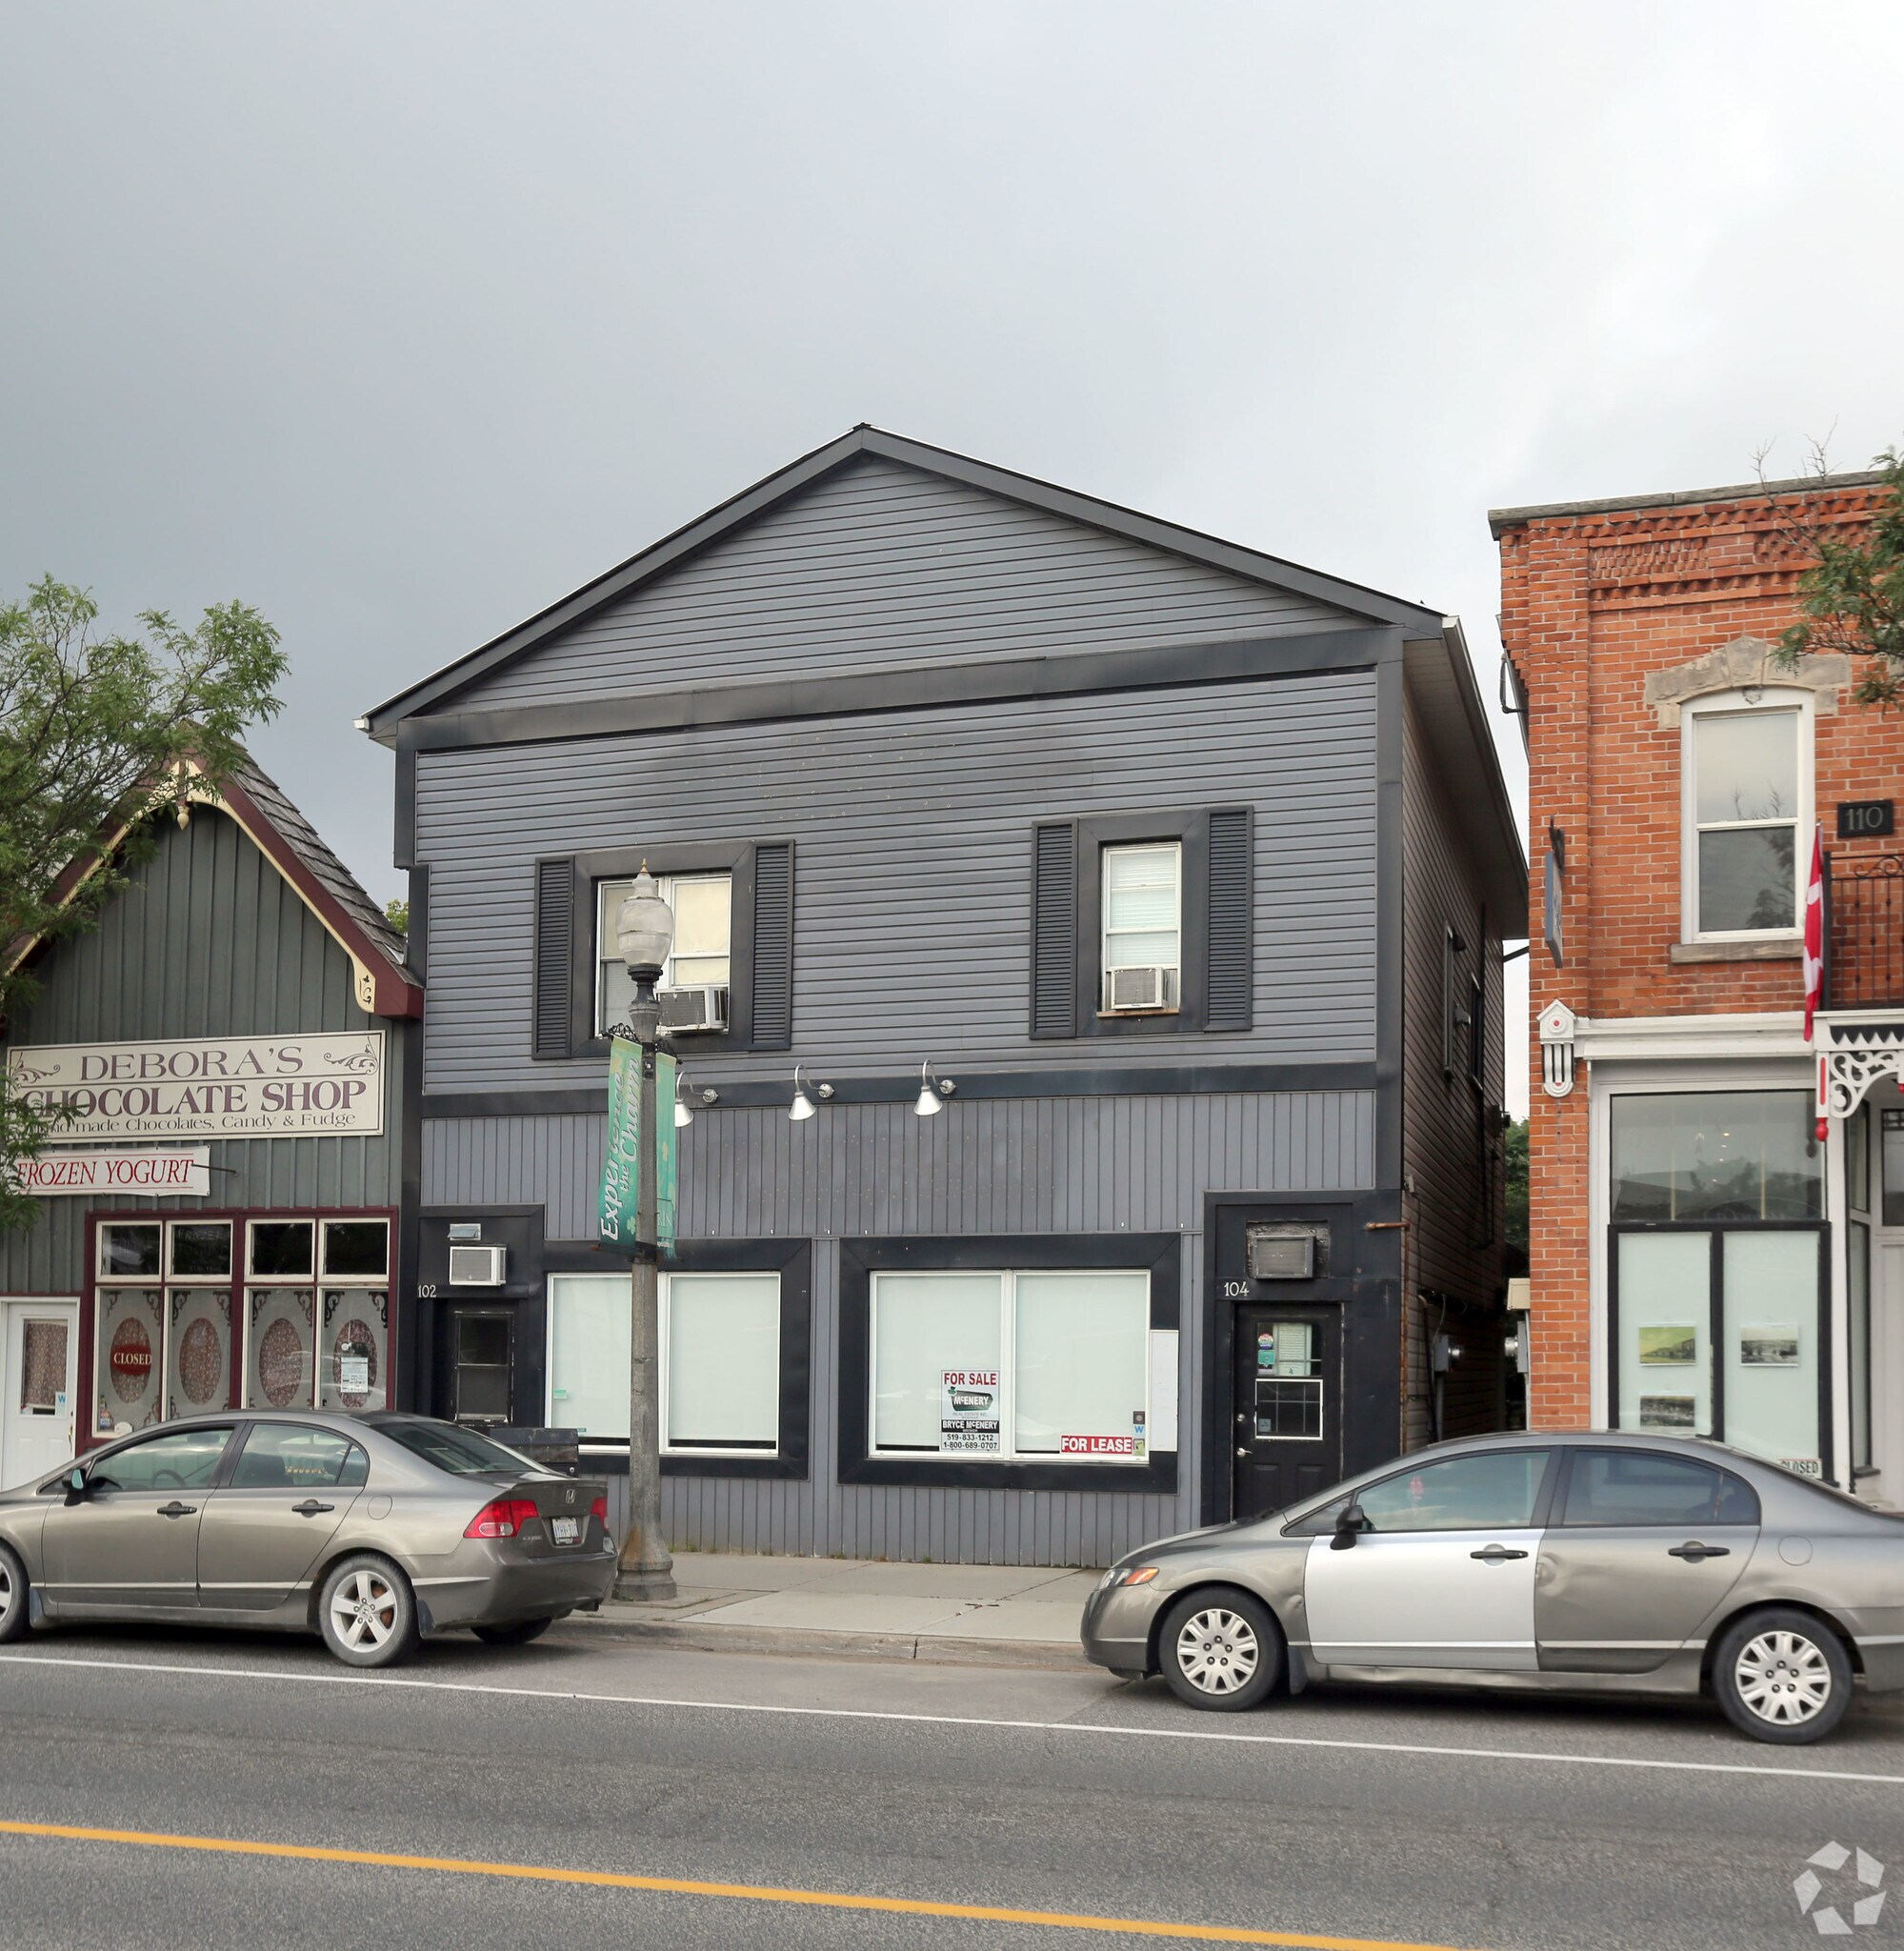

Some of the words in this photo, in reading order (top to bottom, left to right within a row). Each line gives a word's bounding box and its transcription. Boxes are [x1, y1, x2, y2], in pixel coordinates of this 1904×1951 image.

[1846, 806, 1883, 831] 110
[80, 1046, 304, 1081] DEBORA'S
[22, 1085, 248, 1118] CHOCOLATE
[260, 1080, 367, 1113] SHOP
[620, 1057, 640, 1162] Charm
[76, 1117, 120, 1133] made
[126, 1116, 215, 1132] Chocolates,
[221, 1114, 276, 1131] Candy
[283, 1114, 294, 1127] &
[301, 1112, 356, 1128] Fudge
[600, 1073, 623, 1240] Experience
[17, 1160, 98, 1186] FROZEN
[105, 1159, 194, 1184] YOGURT
[620, 1164, 630, 1193] the
[417, 1284, 437, 1298] 102
[1223, 1281, 1250, 1297] 104
[113, 1352, 152, 1365] CLOSED
[944, 1373, 966, 1385] FOR
[969, 1373, 997, 1386] SALE
[942, 1420, 965, 1429] BRYCE
[1062, 1438, 1088, 1451] FOR
[1091, 1438, 1132, 1453] LEASE
